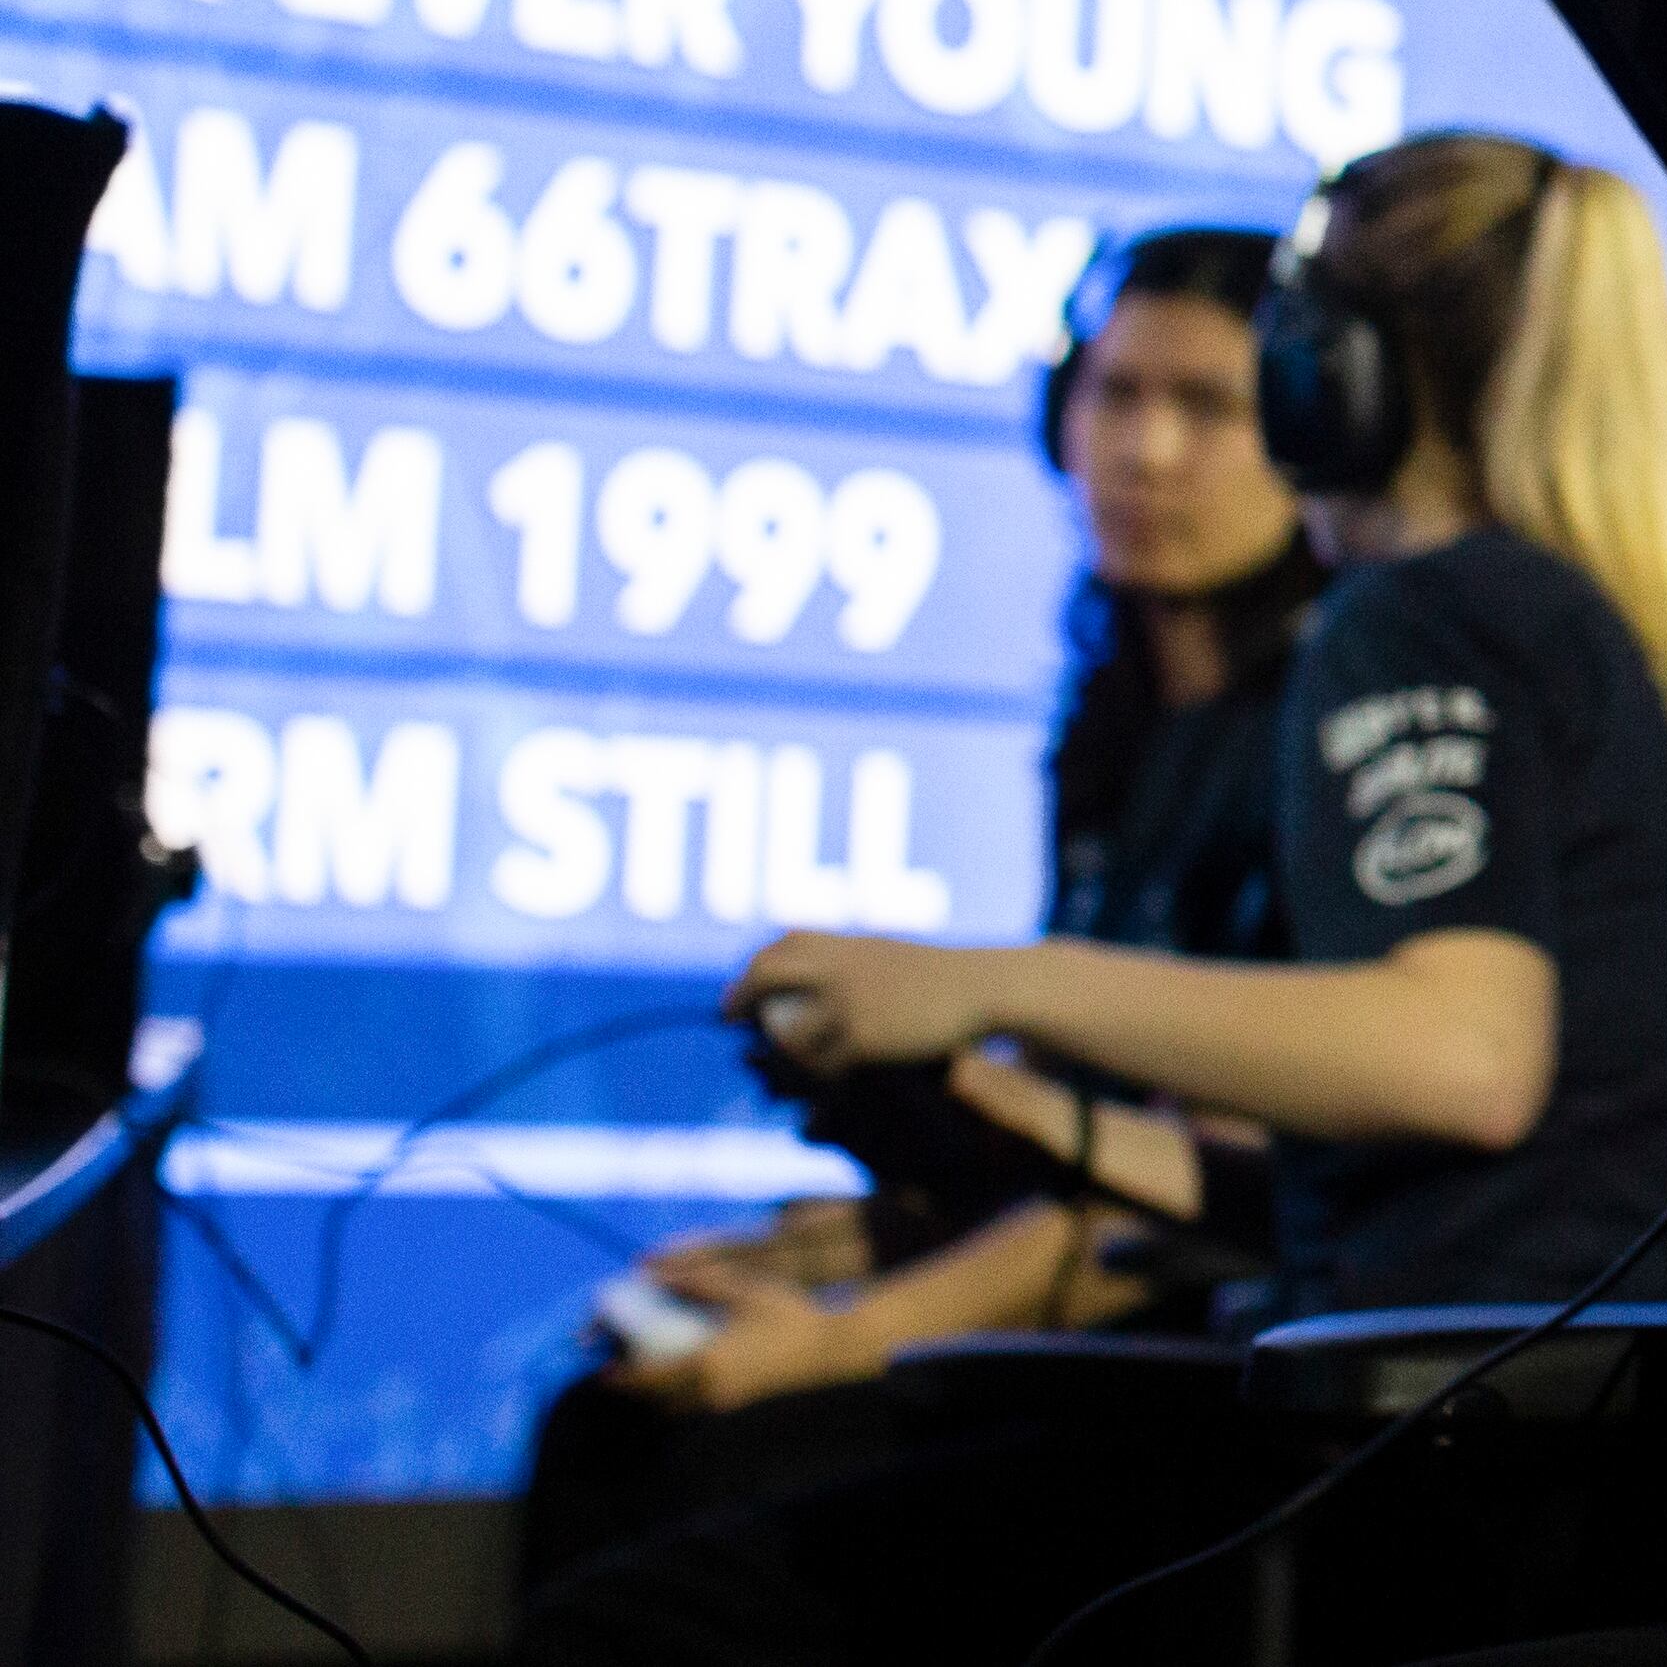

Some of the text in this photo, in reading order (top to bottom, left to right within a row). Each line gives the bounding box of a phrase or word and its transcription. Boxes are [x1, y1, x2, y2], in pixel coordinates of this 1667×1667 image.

[393, 143, 1090, 384] 66TRAX
[490, 443, 939, 651] 1999
[147, 709, 950, 931] RM STILL
